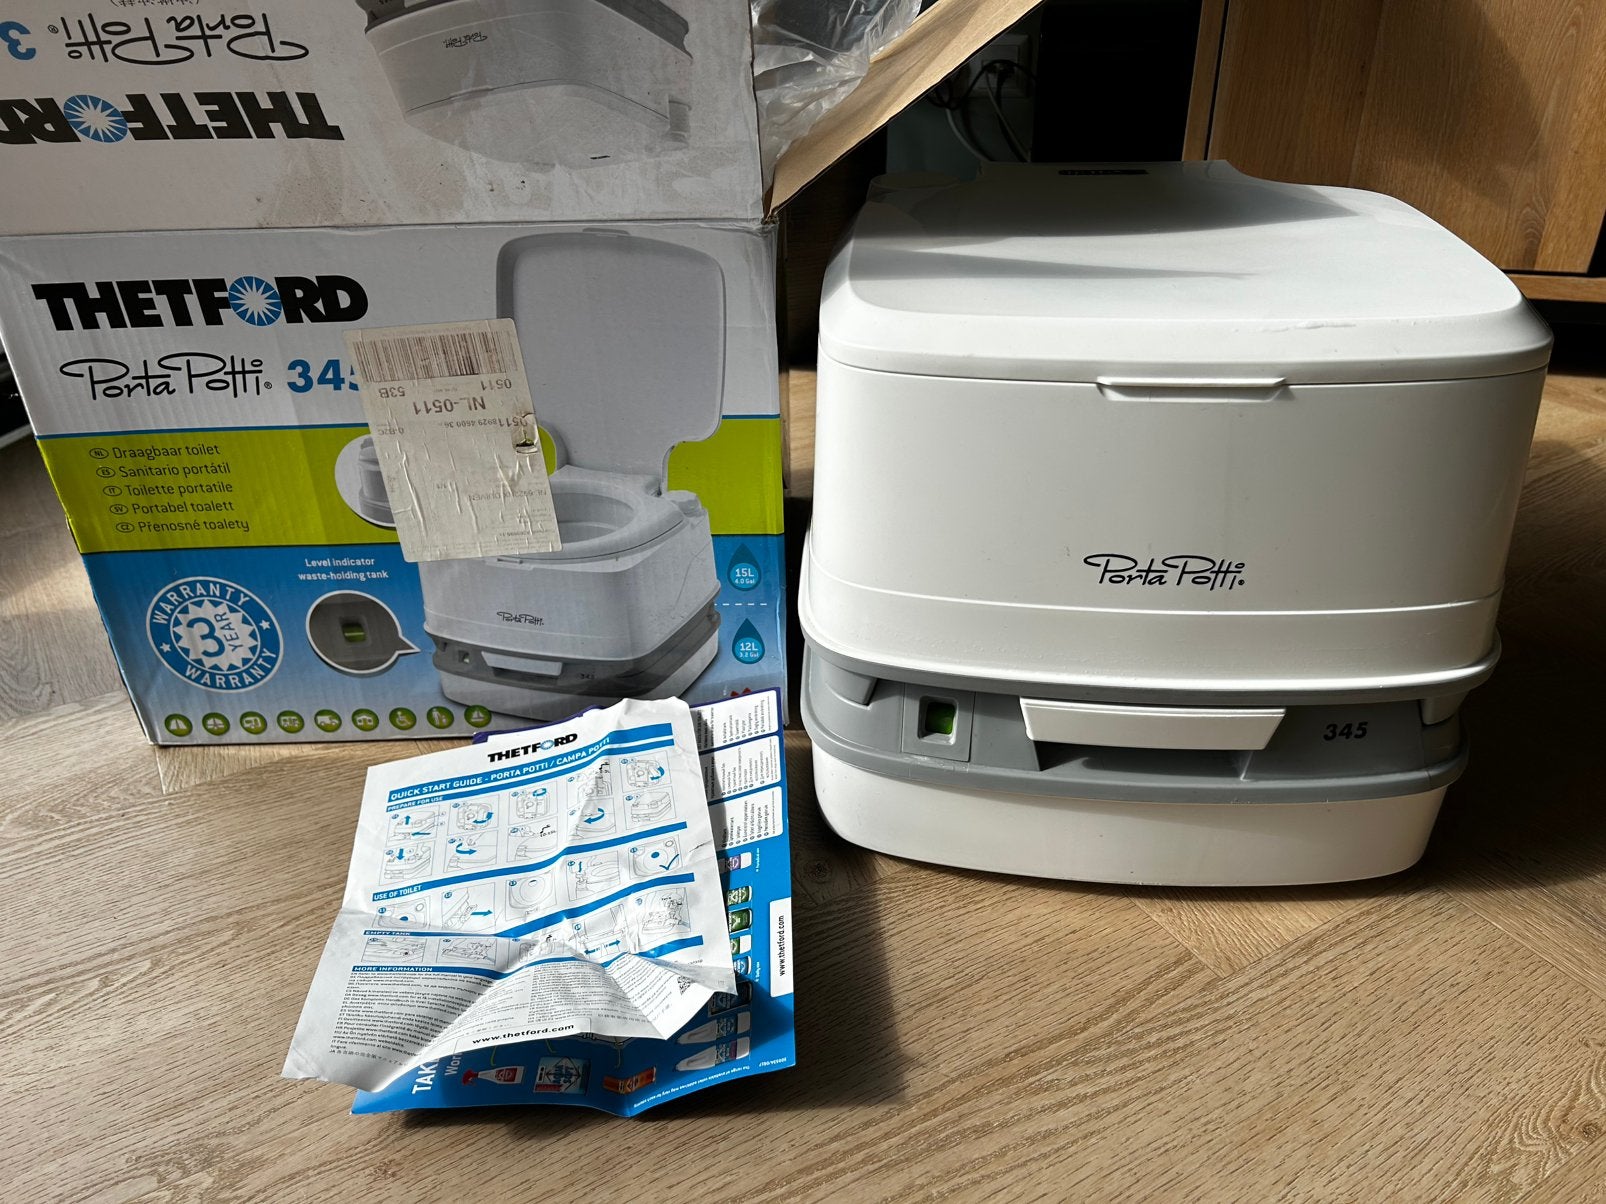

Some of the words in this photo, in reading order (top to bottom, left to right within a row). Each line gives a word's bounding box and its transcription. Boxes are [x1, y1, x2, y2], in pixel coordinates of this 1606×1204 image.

[166, 13, 309, 61] Porta
[31, 275, 369, 331] THETFORD
[59, 358, 176, 400] Porta
[481, 378, 512, 391] 0511
[379, 386, 406, 399] 53B
[413, 396, 486, 415] NL-0511
[112, 447, 182, 460] Draagbaar
[185, 444, 220, 456] toilet
[119, 465, 180, 478] Sanitario
[183, 462, 231, 478] portátil
[125, 484, 175, 497] Toilette
[179, 481, 233, 497] portatile
[132, 502, 189, 515] Portabel
[190, 500, 235, 512] toalett
[203, 518, 250, 532] toalety
[305, 558, 330, 567] Level
[332, 557, 375, 566] indicator
[1083, 553, 1168, 586] Porta
[298, 571, 366, 581] waste-holding
[366, 570, 389, 579] tank
[735, 567, 754, 577] 15L
[153, 582, 250, 625] WARRANTY
[186, 616, 226, 658] 3
[214, 611, 244, 652] YEAR
[739, 642, 758, 651] 12L
[185, 650, 277, 689] WARRANTY
[1323, 721, 1369, 742] 345
[487, 733, 578, 763] THETFORD
[391, 788, 420, 800] QUICK
[422, 782, 451, 793] START
[453, 777, 483, 788] GUIDE
[490, 769, 521, 781] PORTA
[522, 762, 548, 774] POTTI
[556, 751, 587, 765] CAMPA
[588, 736, 610, 755] POTTI
[387, 800, 416, 812] PREPARE
[373, 892, 388, 900] USE
[388, 890, 398, 898] OF
[400, 885, 422, 896] TOILET
[777, 915, 786, 976] www.thetford.com
[472, 1024, 575, 1045] www.thetford.com
